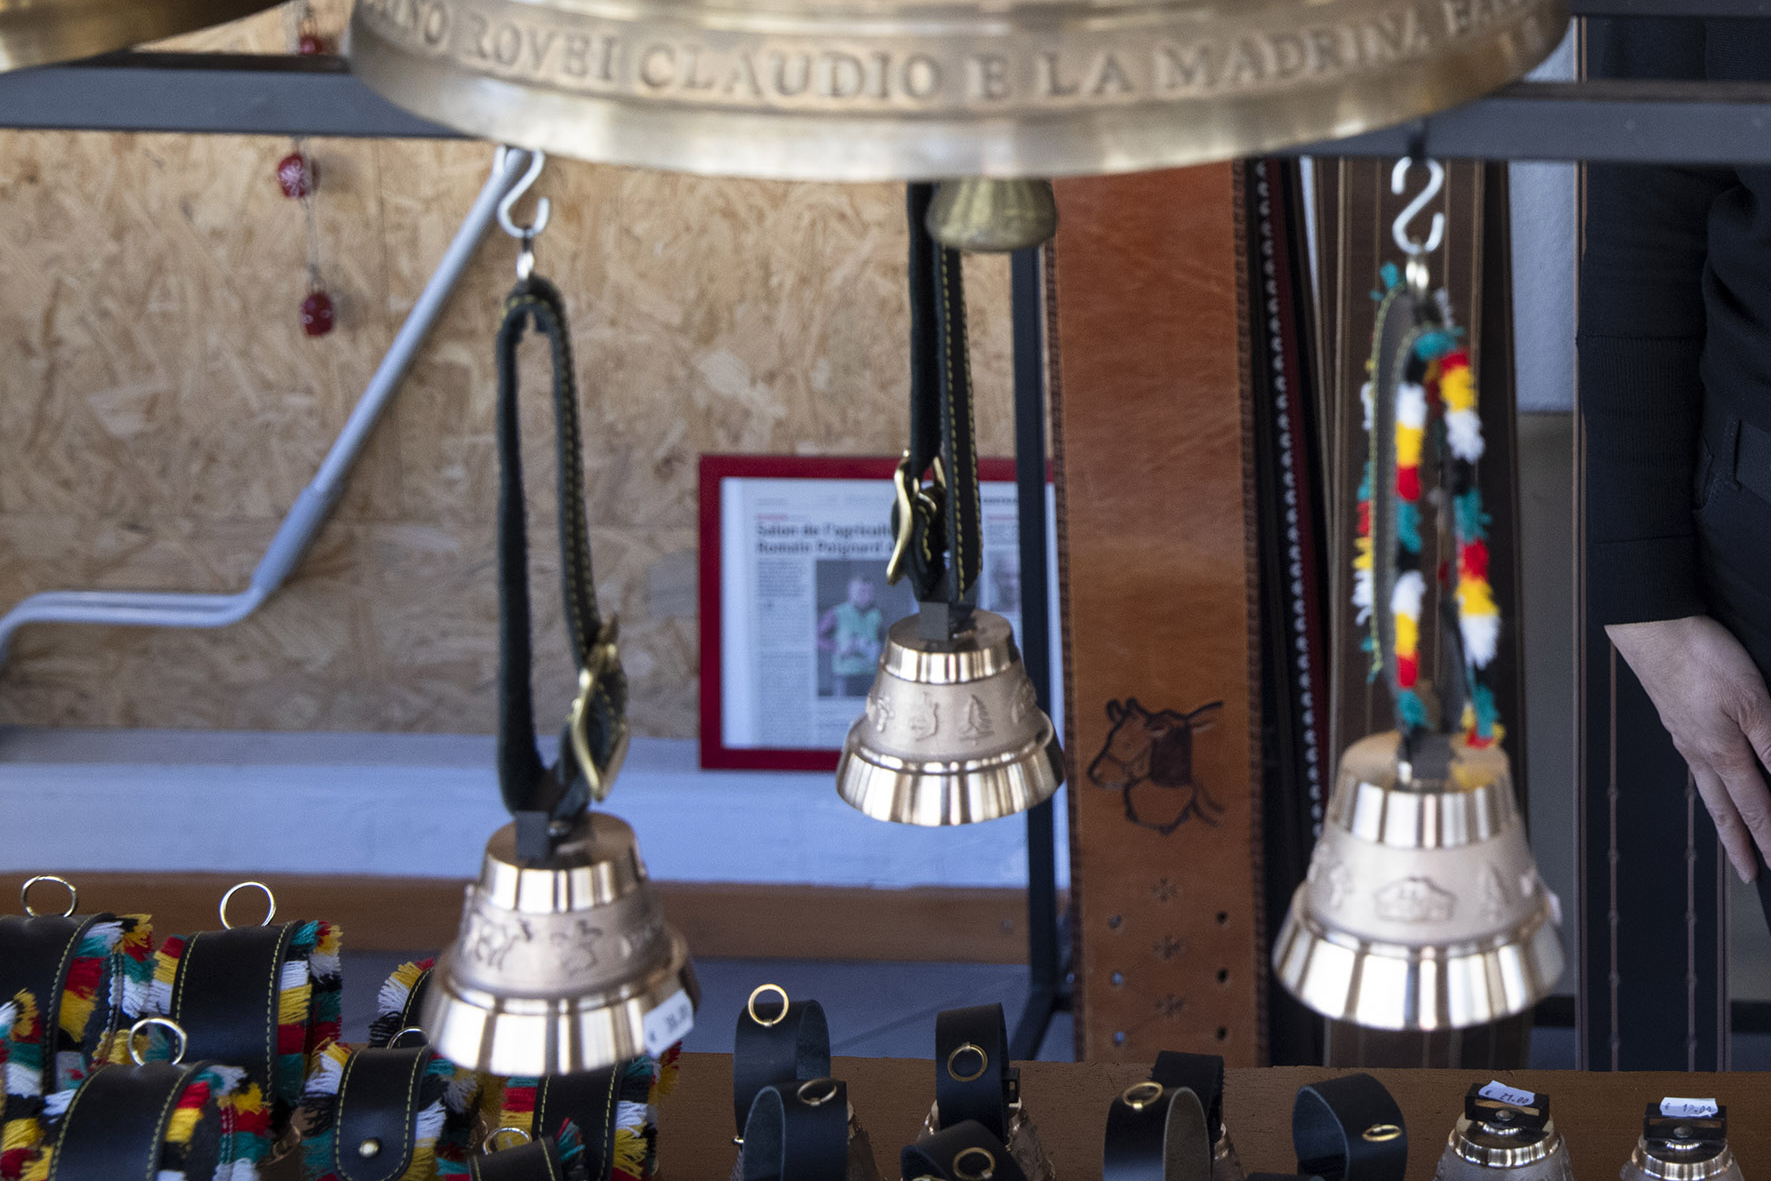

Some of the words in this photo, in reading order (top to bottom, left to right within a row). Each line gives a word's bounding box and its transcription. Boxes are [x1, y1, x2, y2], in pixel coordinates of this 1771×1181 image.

[636, 40, 943, 103] CLAUDIO
[968, 55, 1011, 101] E
[1036, 49, 1133, 100] LA
[1155, 10, 1432, 93] MADRINA
